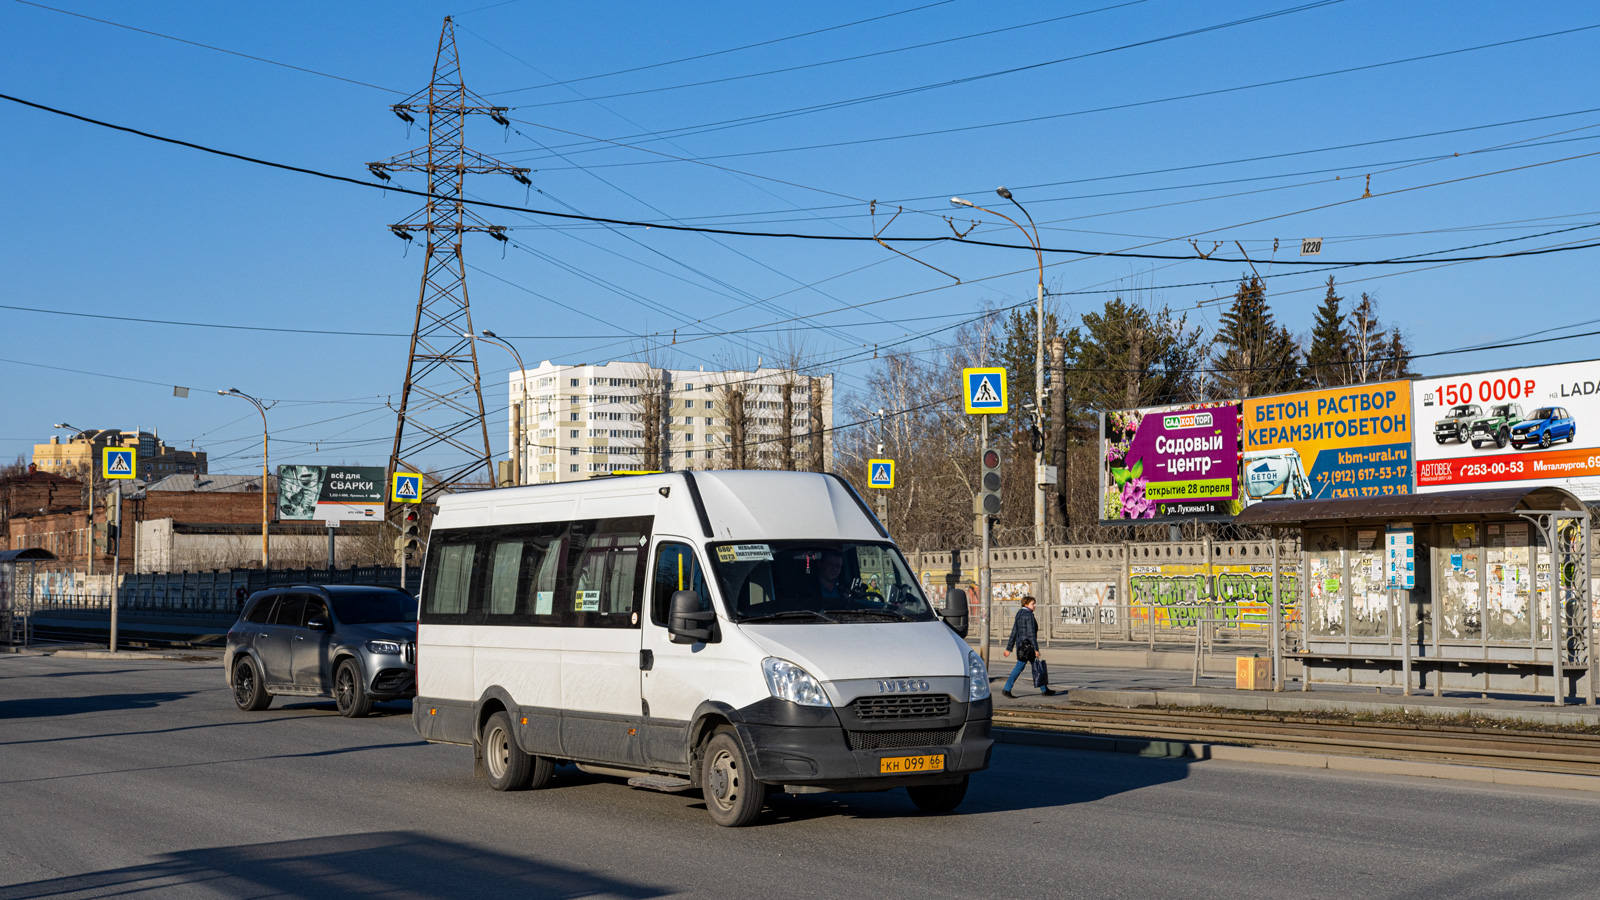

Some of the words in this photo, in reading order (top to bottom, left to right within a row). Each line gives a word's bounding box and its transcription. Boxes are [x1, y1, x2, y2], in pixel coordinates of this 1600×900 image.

[1302, 241, 1322, 253] 1220
[1424, 393, 1434, 403] до
[1435, 382, 1473, 406] 150
[1256, 400, 1309, 423] БЕТОН
[1317, 390, 1396, 416] РАСТВОР
[1248, 414, 1406, 446] КЕРАМЗИТОБЕТОН
[1156, 429, 1223, 455] Садовый
[1338, 448, 1407, 464] kbm-ural.ru
[1251, 472, 1278, 480] БЕТОН
[1316, 471, 1328, 483] +7
[1331, 470, 1355, 485] (912)
[1358, 466, 1407, 481] 617-53-17
[1421, 462, 1452, 477] АВТОВЕК
[1467, 461, 1524, 476] 253-00-53
[330, 480, 373, 490] СВАРКИ
[1148, 486, 1186, 497] открытие
[1187, 484, 1198, 494] 28
[1200, 483, 1230, 496] апреля
[1396, 484, 1408, 495] 18
[1167, 506, 1176, 515] ул.
[1177, 504, 1205, 513] Лукиных
[877, 679, 930, 693] IVECO
[904, 757, 924, 770] 099
[930, 755, 940, 764] 66
